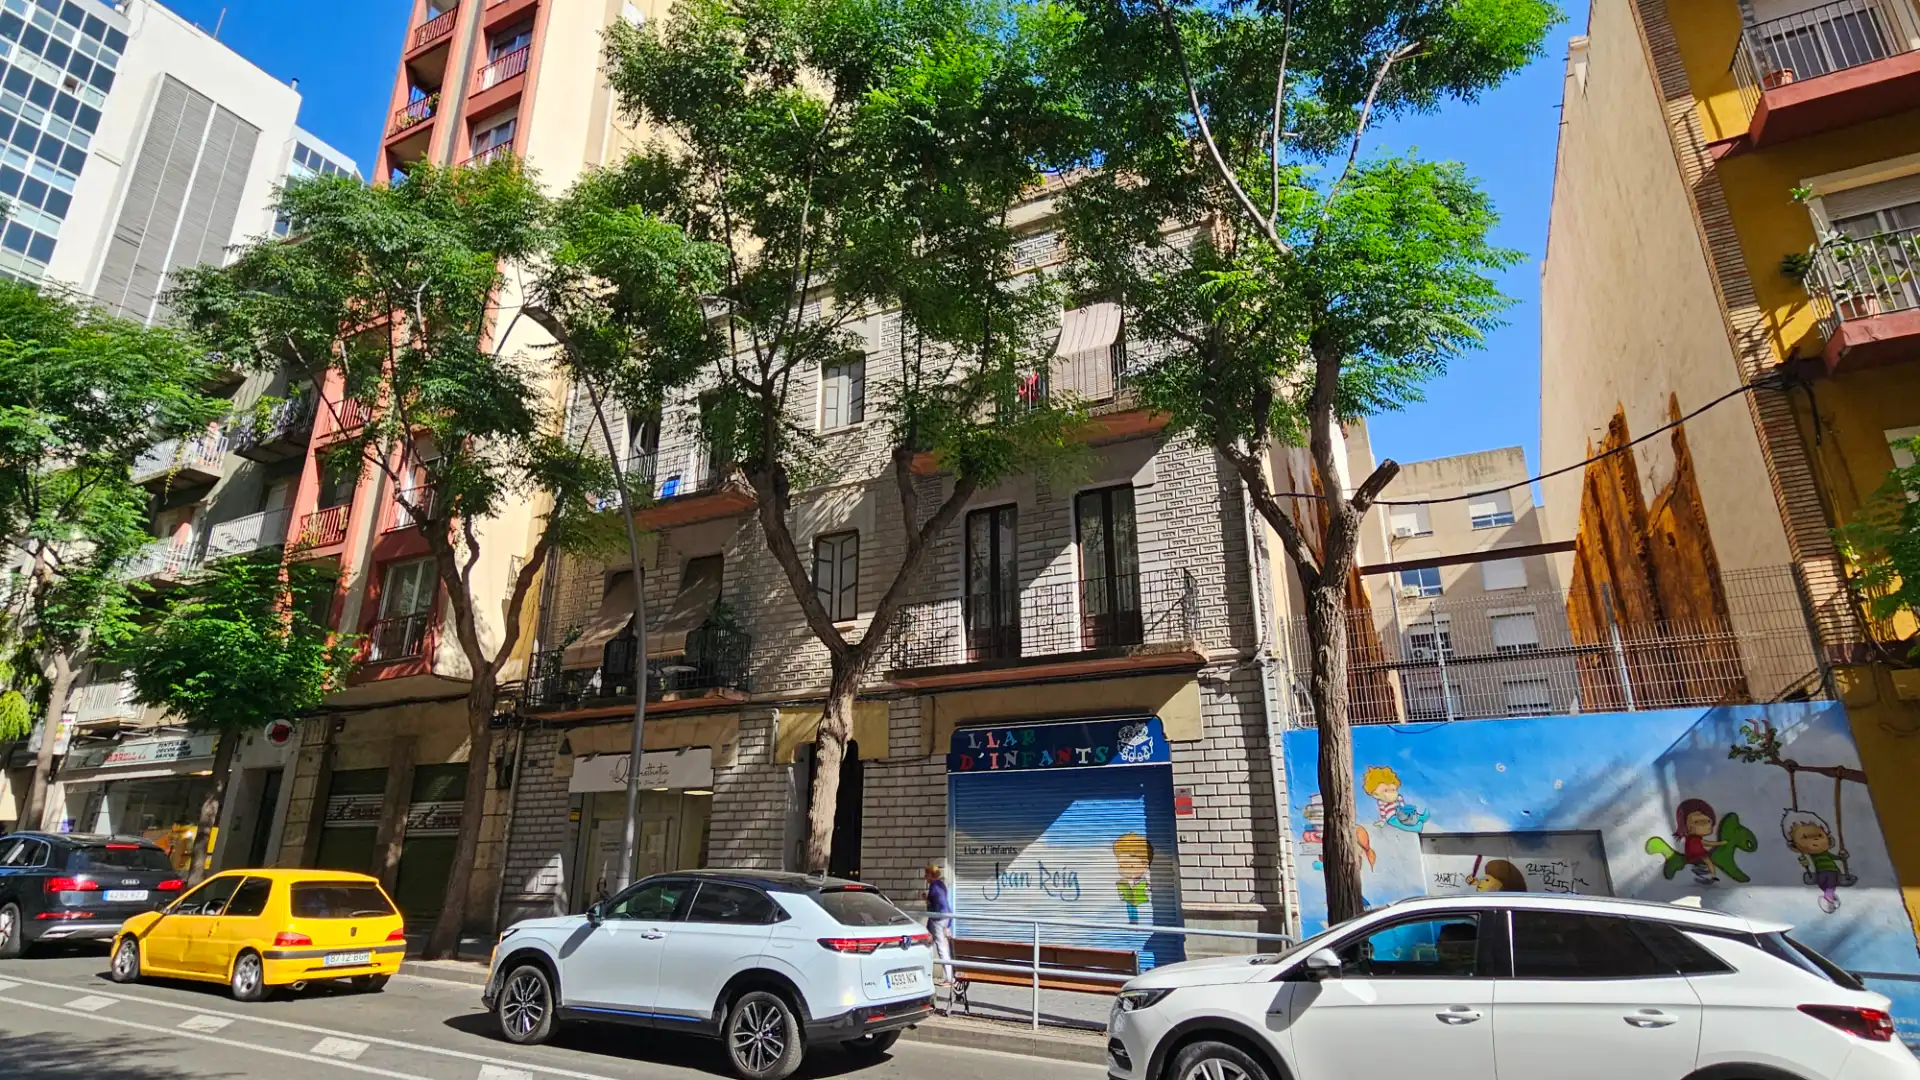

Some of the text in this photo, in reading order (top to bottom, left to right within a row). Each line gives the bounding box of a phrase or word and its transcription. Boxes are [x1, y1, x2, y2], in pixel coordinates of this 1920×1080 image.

[968, 729, 1036, 748] LLAR
[959, 746, 1109, 770] D'INFANTS
[982, 861, 1080, 902] Joan Roig
